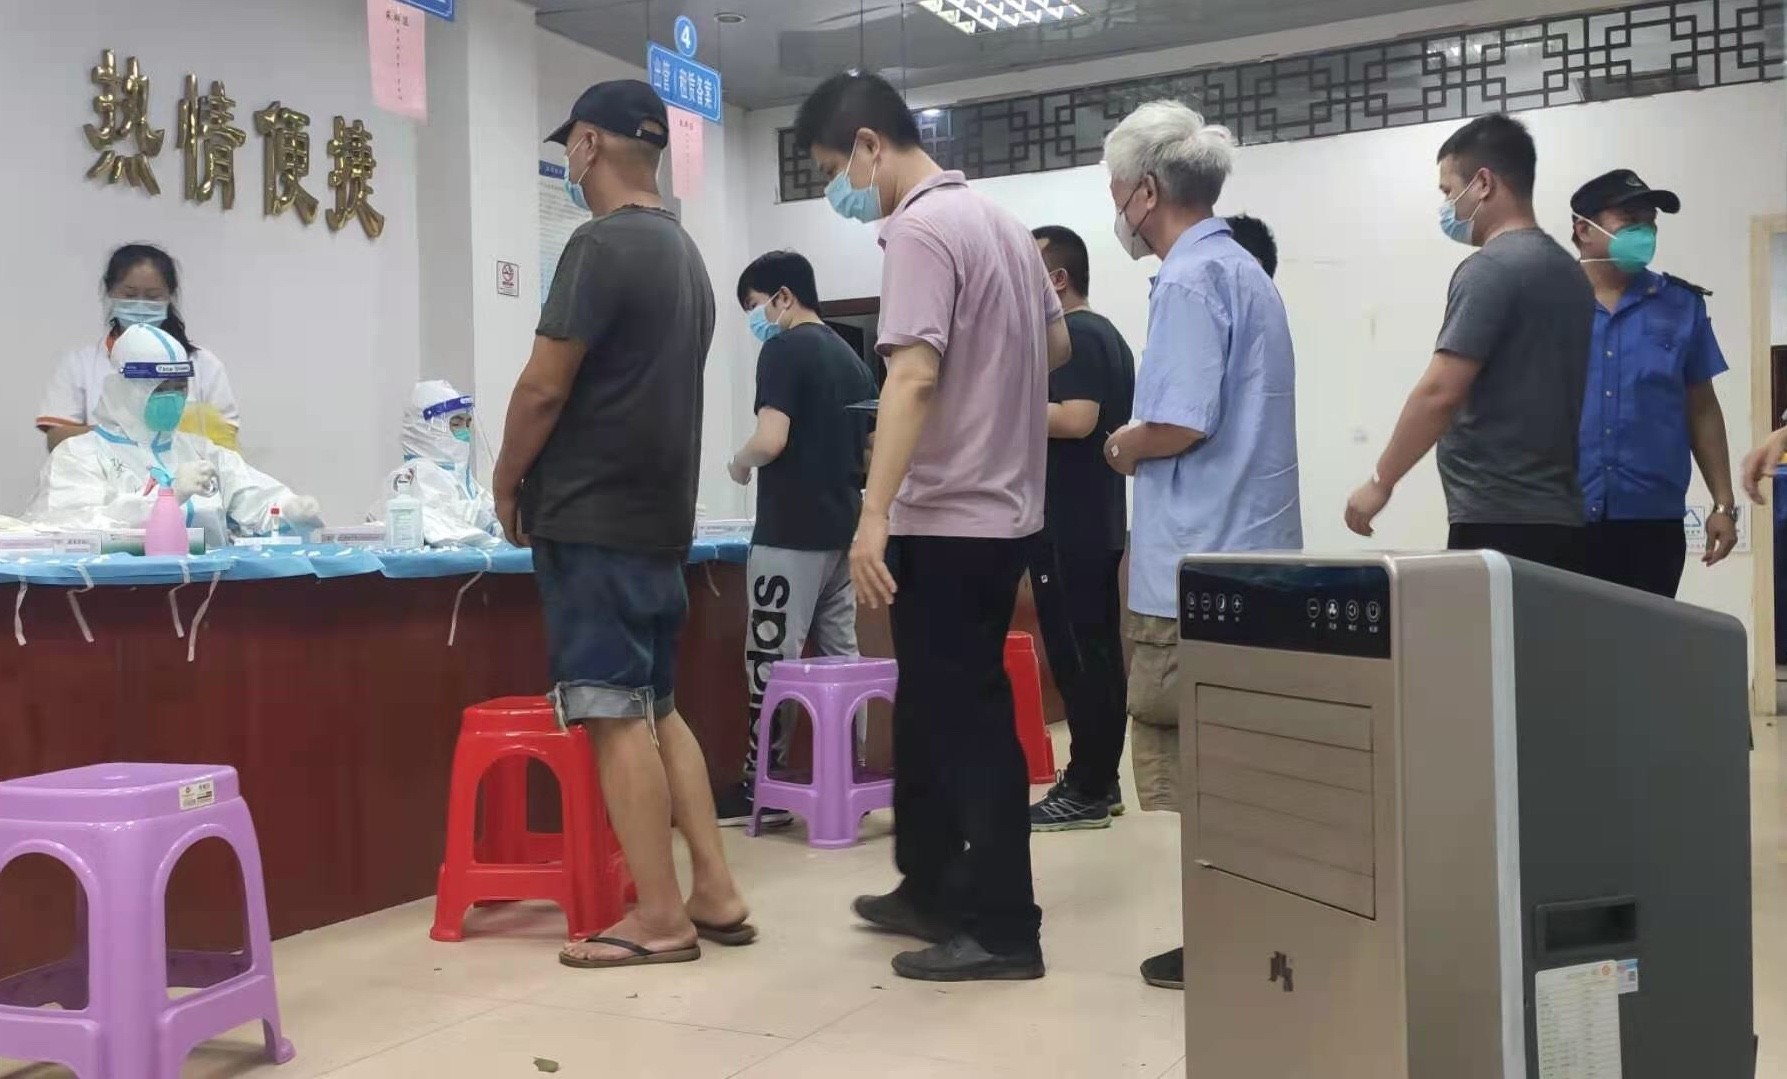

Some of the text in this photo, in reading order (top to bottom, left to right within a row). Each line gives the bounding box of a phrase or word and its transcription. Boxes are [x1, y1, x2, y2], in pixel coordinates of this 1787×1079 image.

[680, 25, 691, 49] 4
[83, 49, 385, 239] 热情便捷
